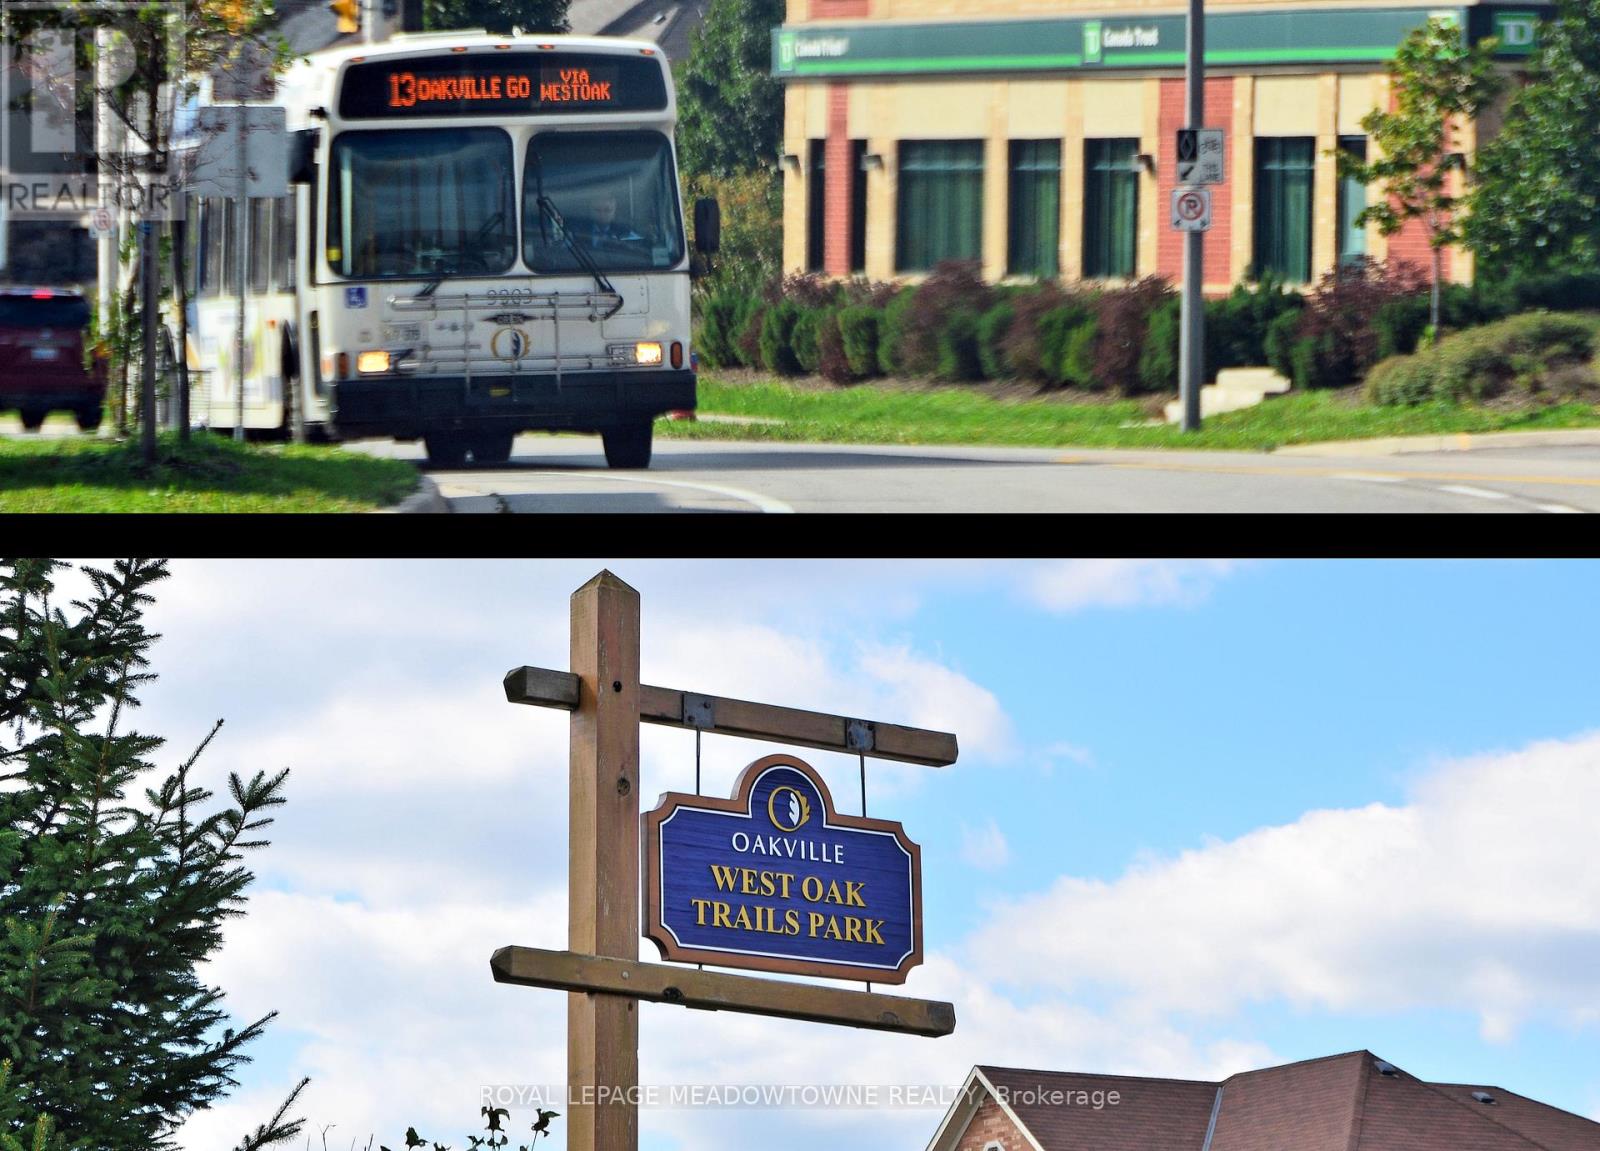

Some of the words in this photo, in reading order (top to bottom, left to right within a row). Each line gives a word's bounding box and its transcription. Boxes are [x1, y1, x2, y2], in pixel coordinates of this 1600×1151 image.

[389, 72, 416, 107] 13
[417, 77, 501, 101] OAKVILLE
[506, 75, 530, 99] GO
[560, 68, 589, 84] VIA
[731, 832, 844, 864] OAKVILLE
[710, 864, 795, 899] WEST
[801, 876, 867, 908] OAK
[691, 898, 800, 936] TRAILS
[807, 911, 886, 945] PARK
